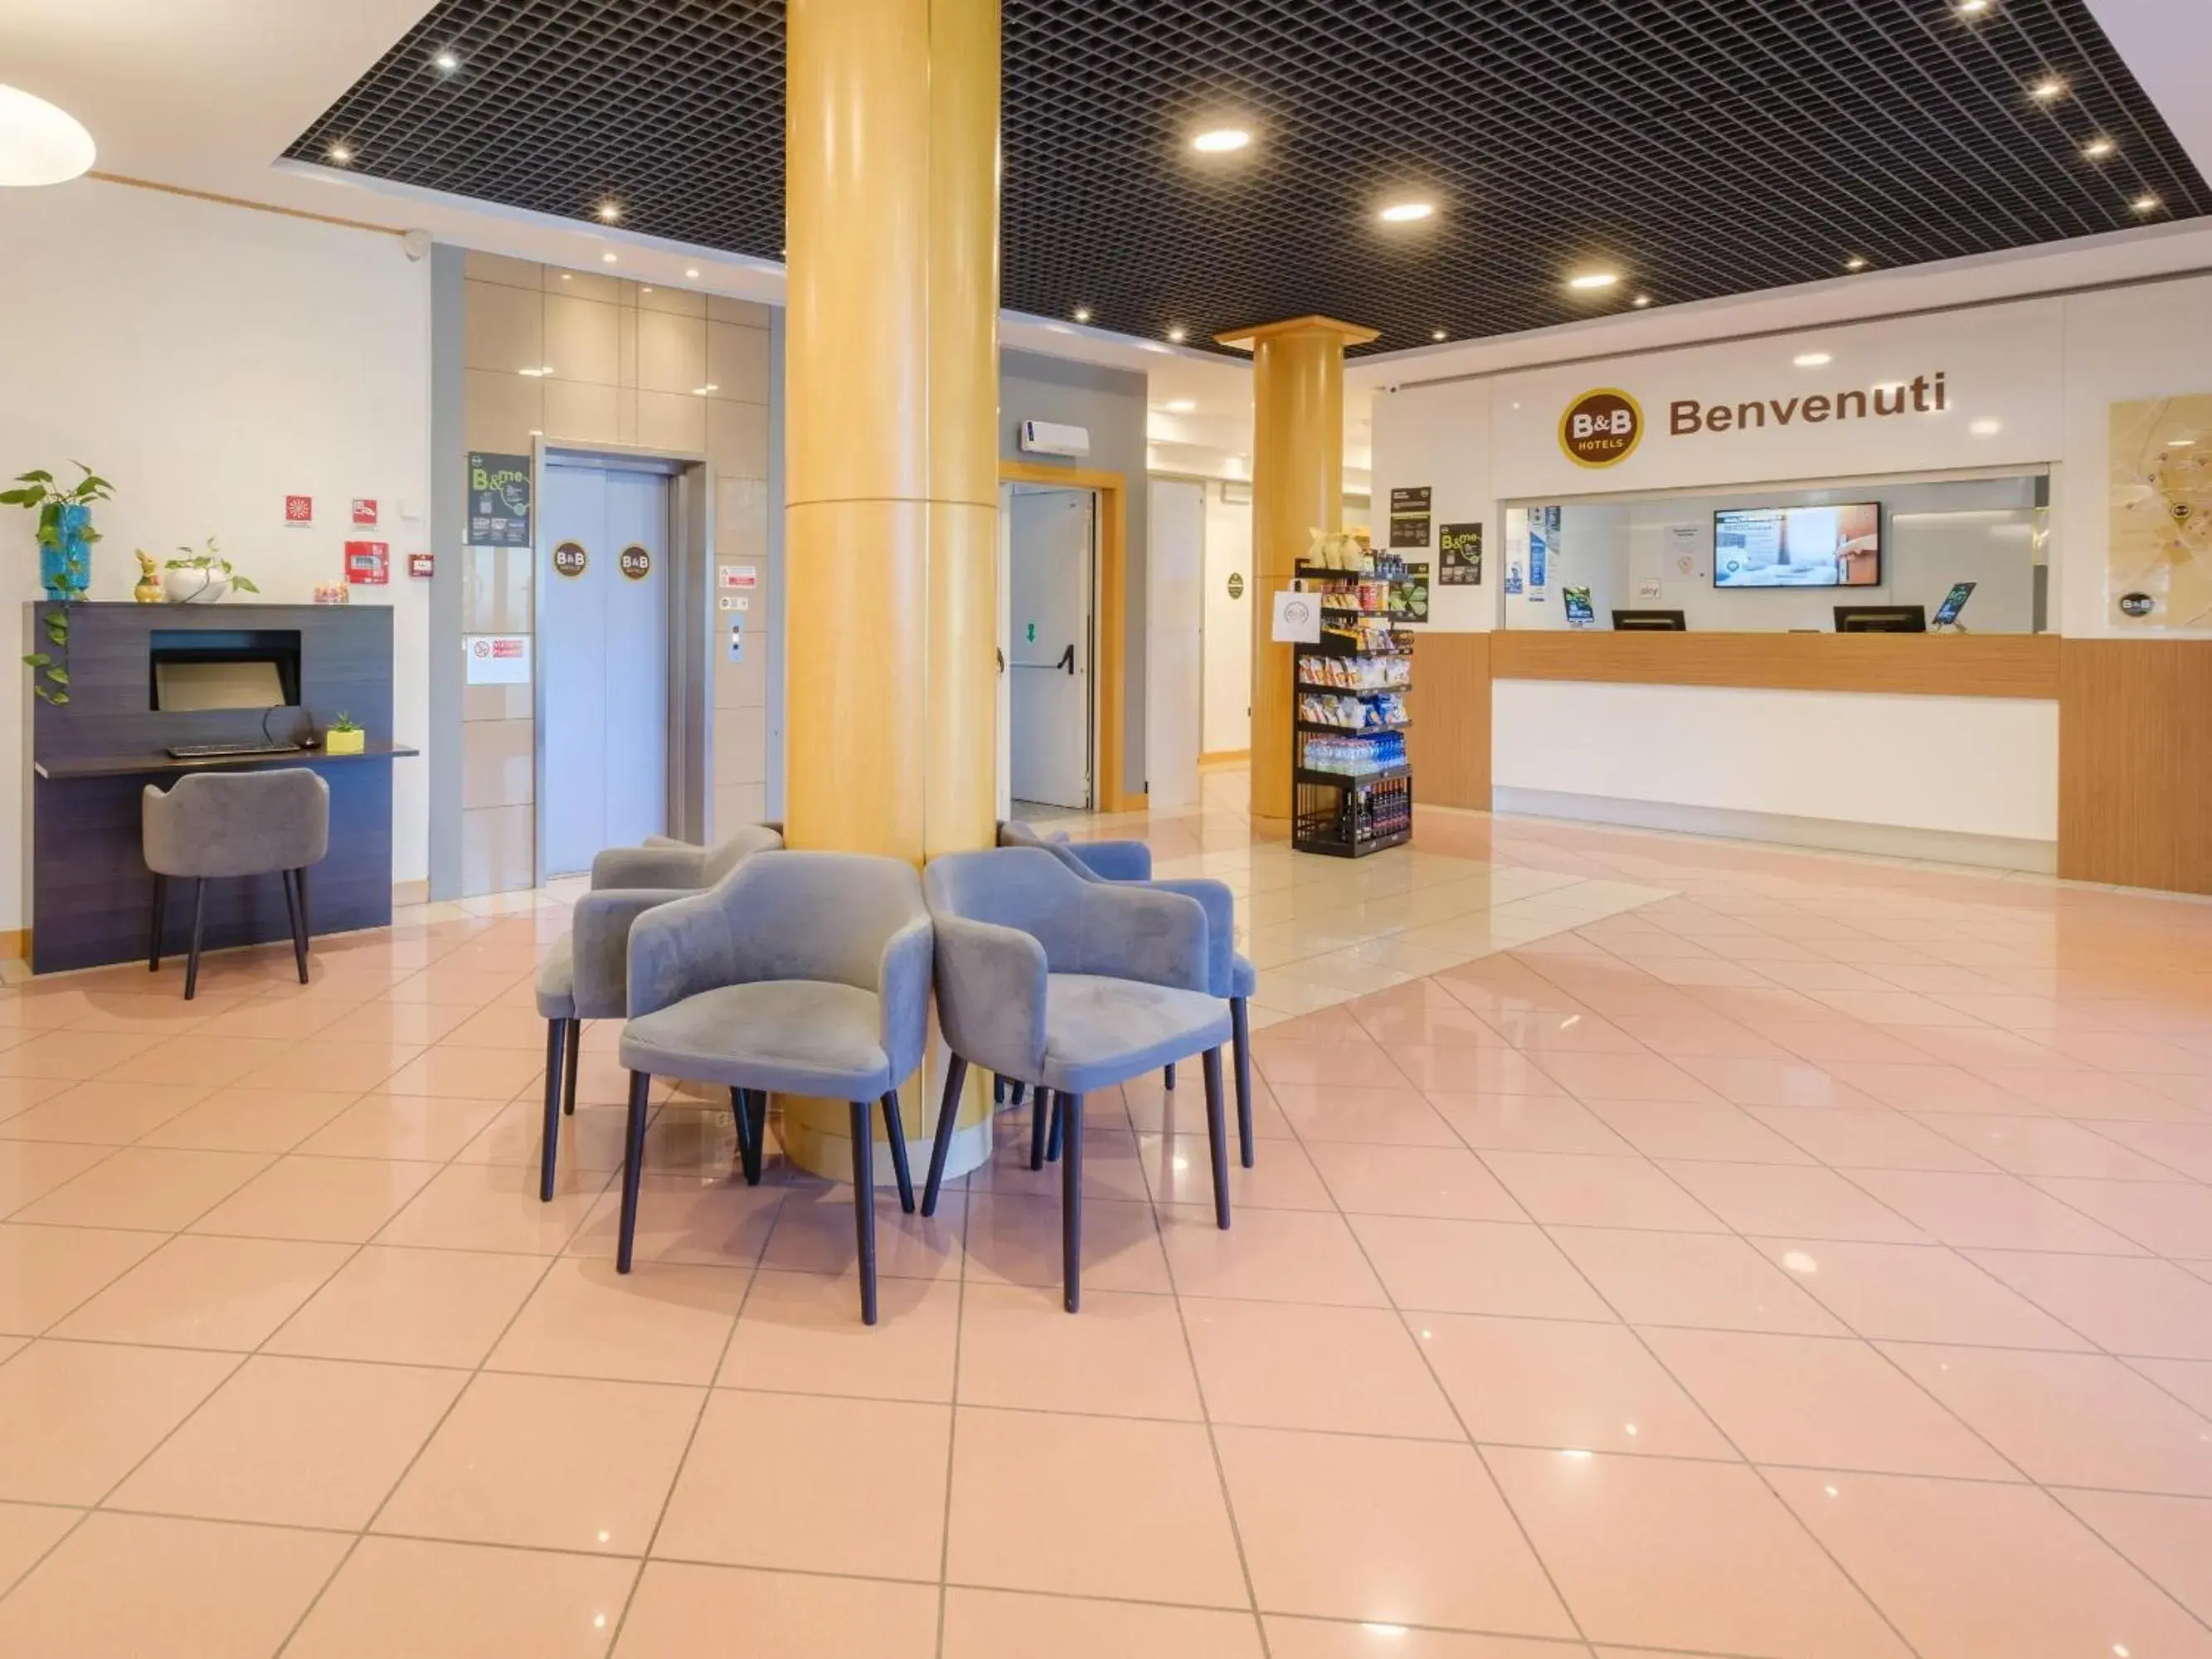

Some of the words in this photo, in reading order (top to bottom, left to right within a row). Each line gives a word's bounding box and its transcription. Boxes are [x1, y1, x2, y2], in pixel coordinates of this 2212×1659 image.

[1670, 372, 1946, 435] Benvenuti
[1573, 409, 1632, 439] B&B
[1578, 438, 1623, 451] HOTELS
[557, 552, 586, 566] B&B
[623, 555, 649, 568] B&B
